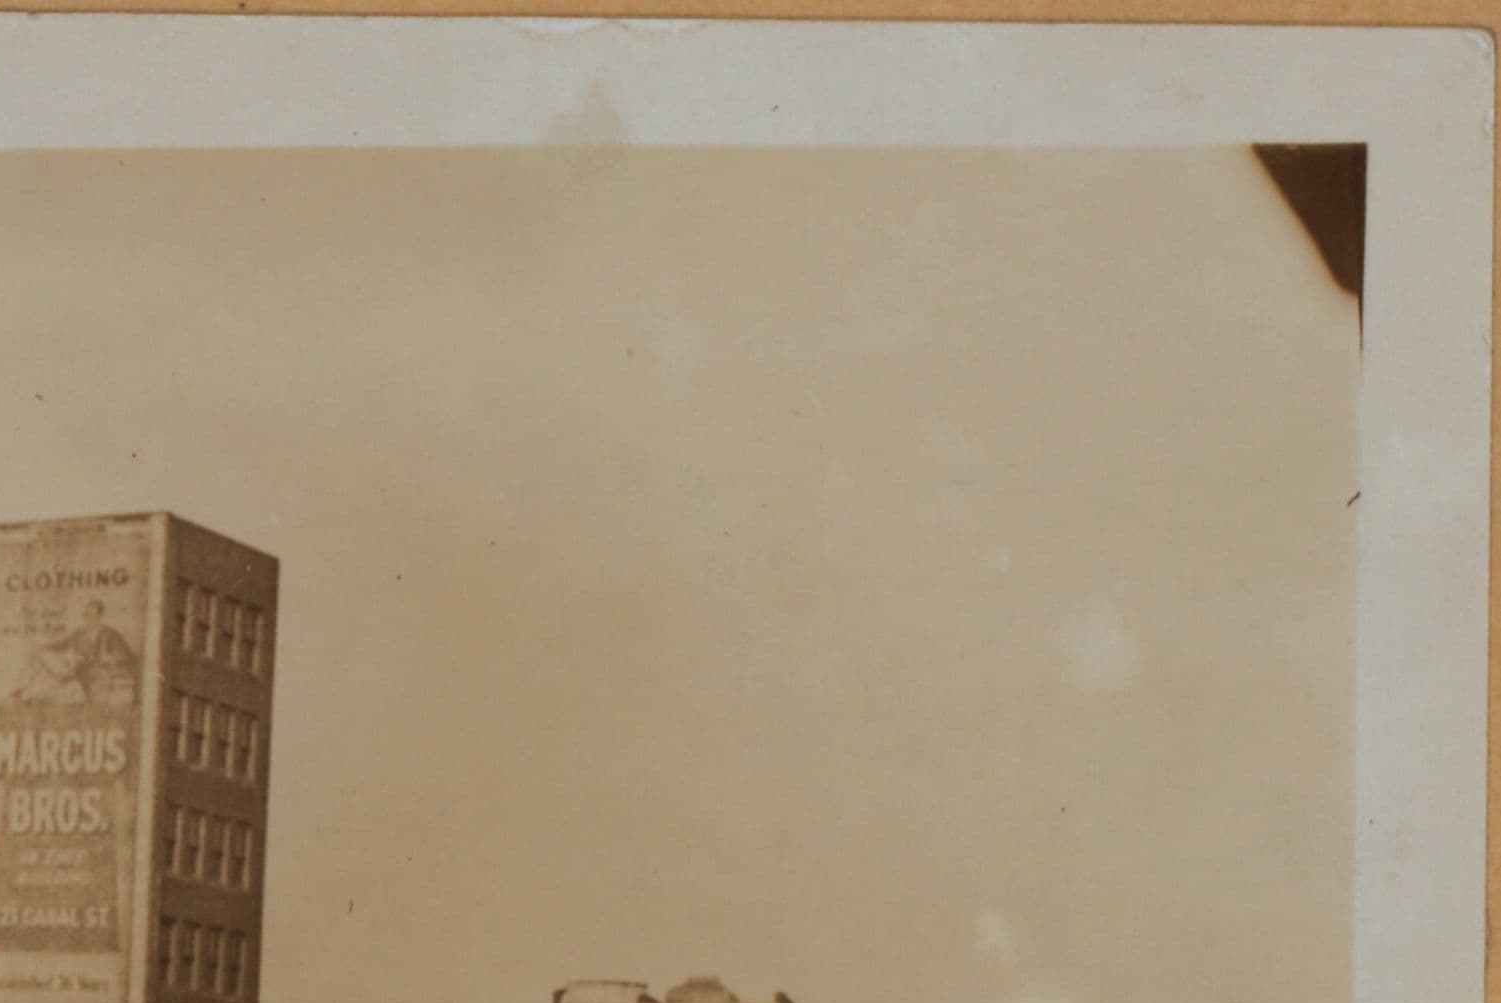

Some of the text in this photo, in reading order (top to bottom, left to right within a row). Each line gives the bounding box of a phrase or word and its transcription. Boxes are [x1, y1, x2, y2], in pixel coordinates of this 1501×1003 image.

[6, 567, 130, 593] CLOTHING
[9, 789, 109, 834] BROS.
[21, 904, 80, 928] CANAL
